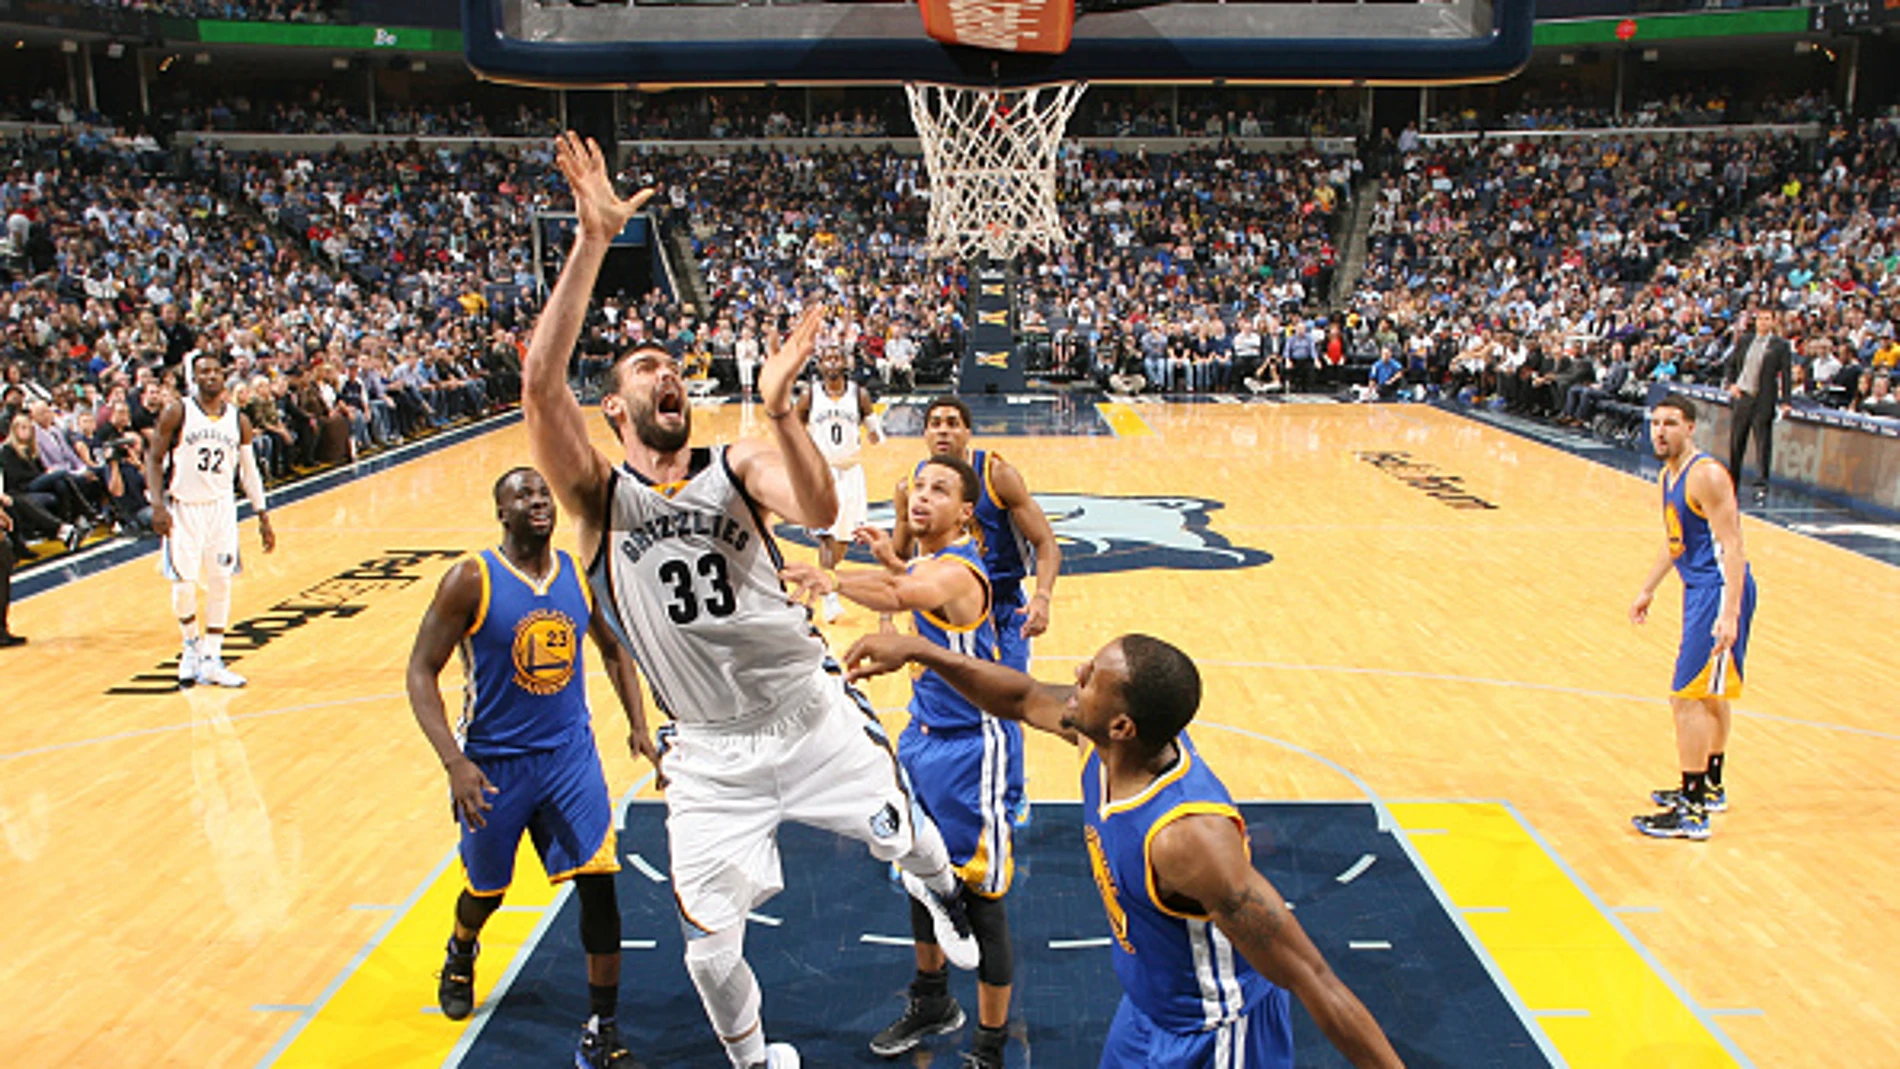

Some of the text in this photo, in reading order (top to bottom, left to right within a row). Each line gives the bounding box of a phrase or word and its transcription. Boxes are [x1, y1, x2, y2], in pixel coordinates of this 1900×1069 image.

[831, 423, 842, 445] 0
[198, 447, 224, 474] 32
[621, 511, 749, 563] GRIZZLIES
[659, 553, 736, 624] 33
[546, 630, 567, 648] 23
